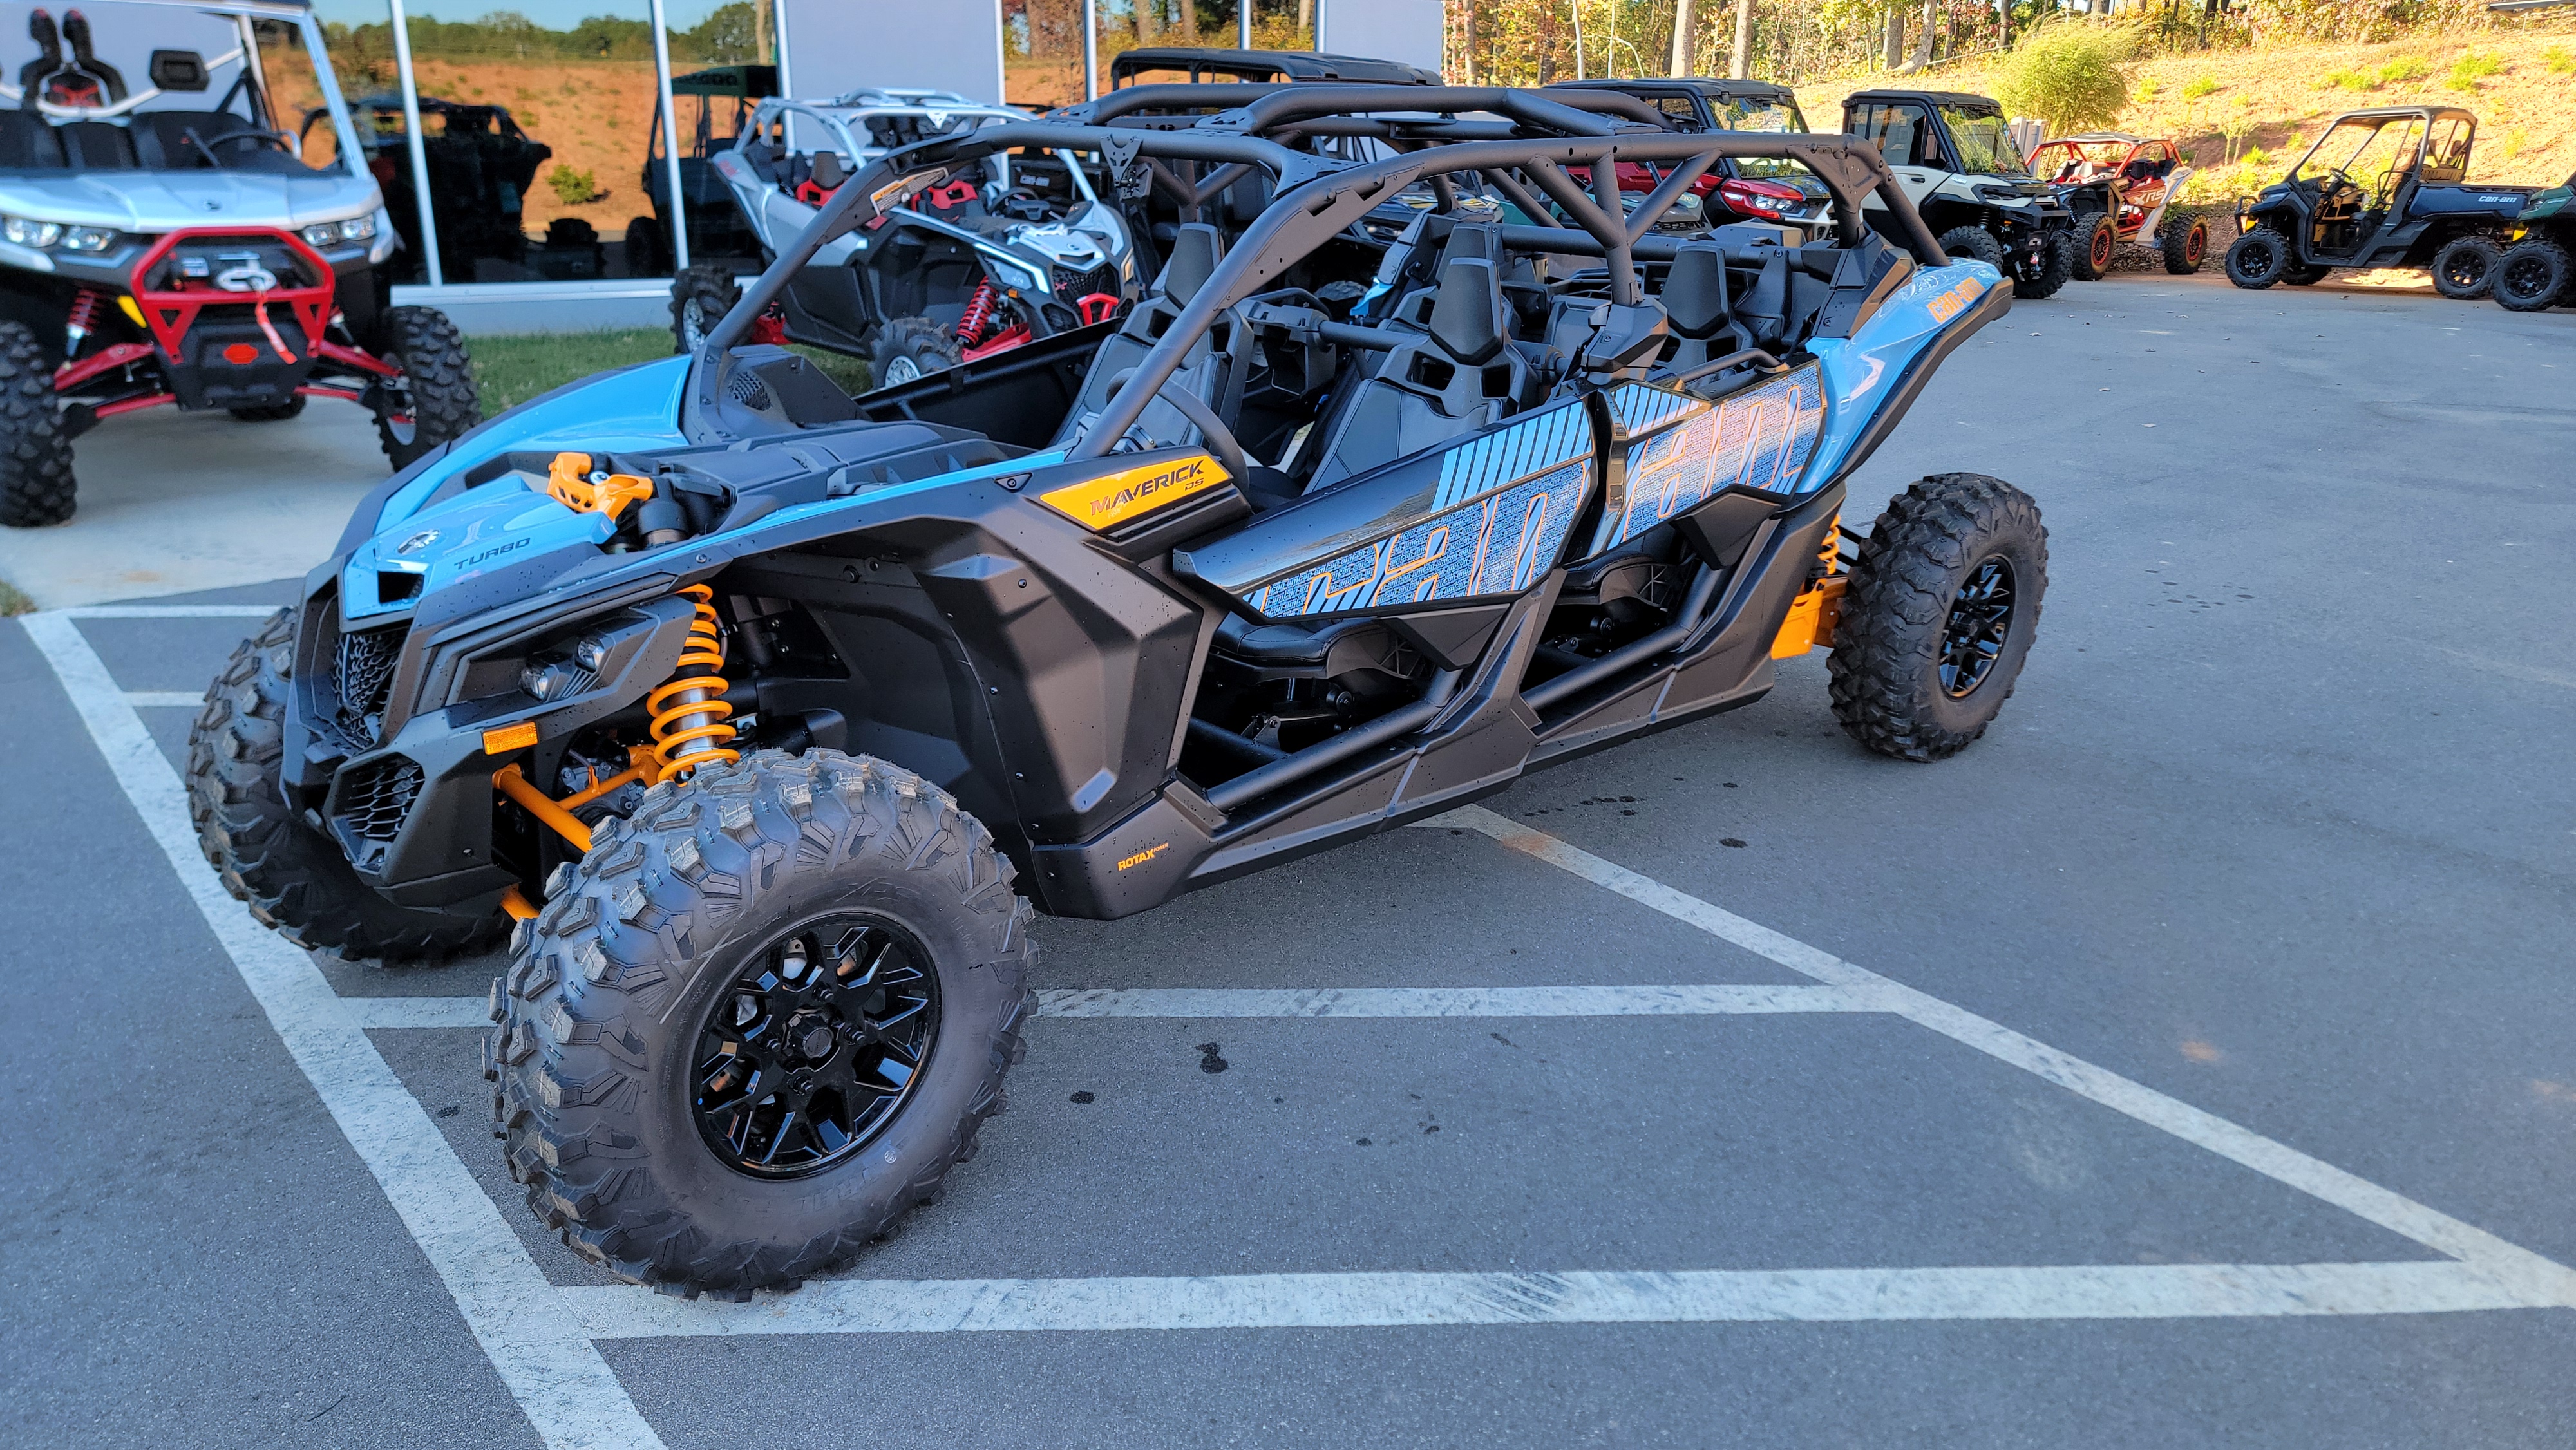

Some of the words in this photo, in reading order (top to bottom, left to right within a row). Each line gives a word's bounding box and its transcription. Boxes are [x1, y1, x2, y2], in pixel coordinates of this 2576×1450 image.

[1927, 276, 1985, 323] can-am
[1090, 459, 1204, 516] MAVERICK
[1184, 477, 1204, 491] DS
[453, 537, 531, 570] TURBO
[1117, 849, 1155, 871] ROTAX
